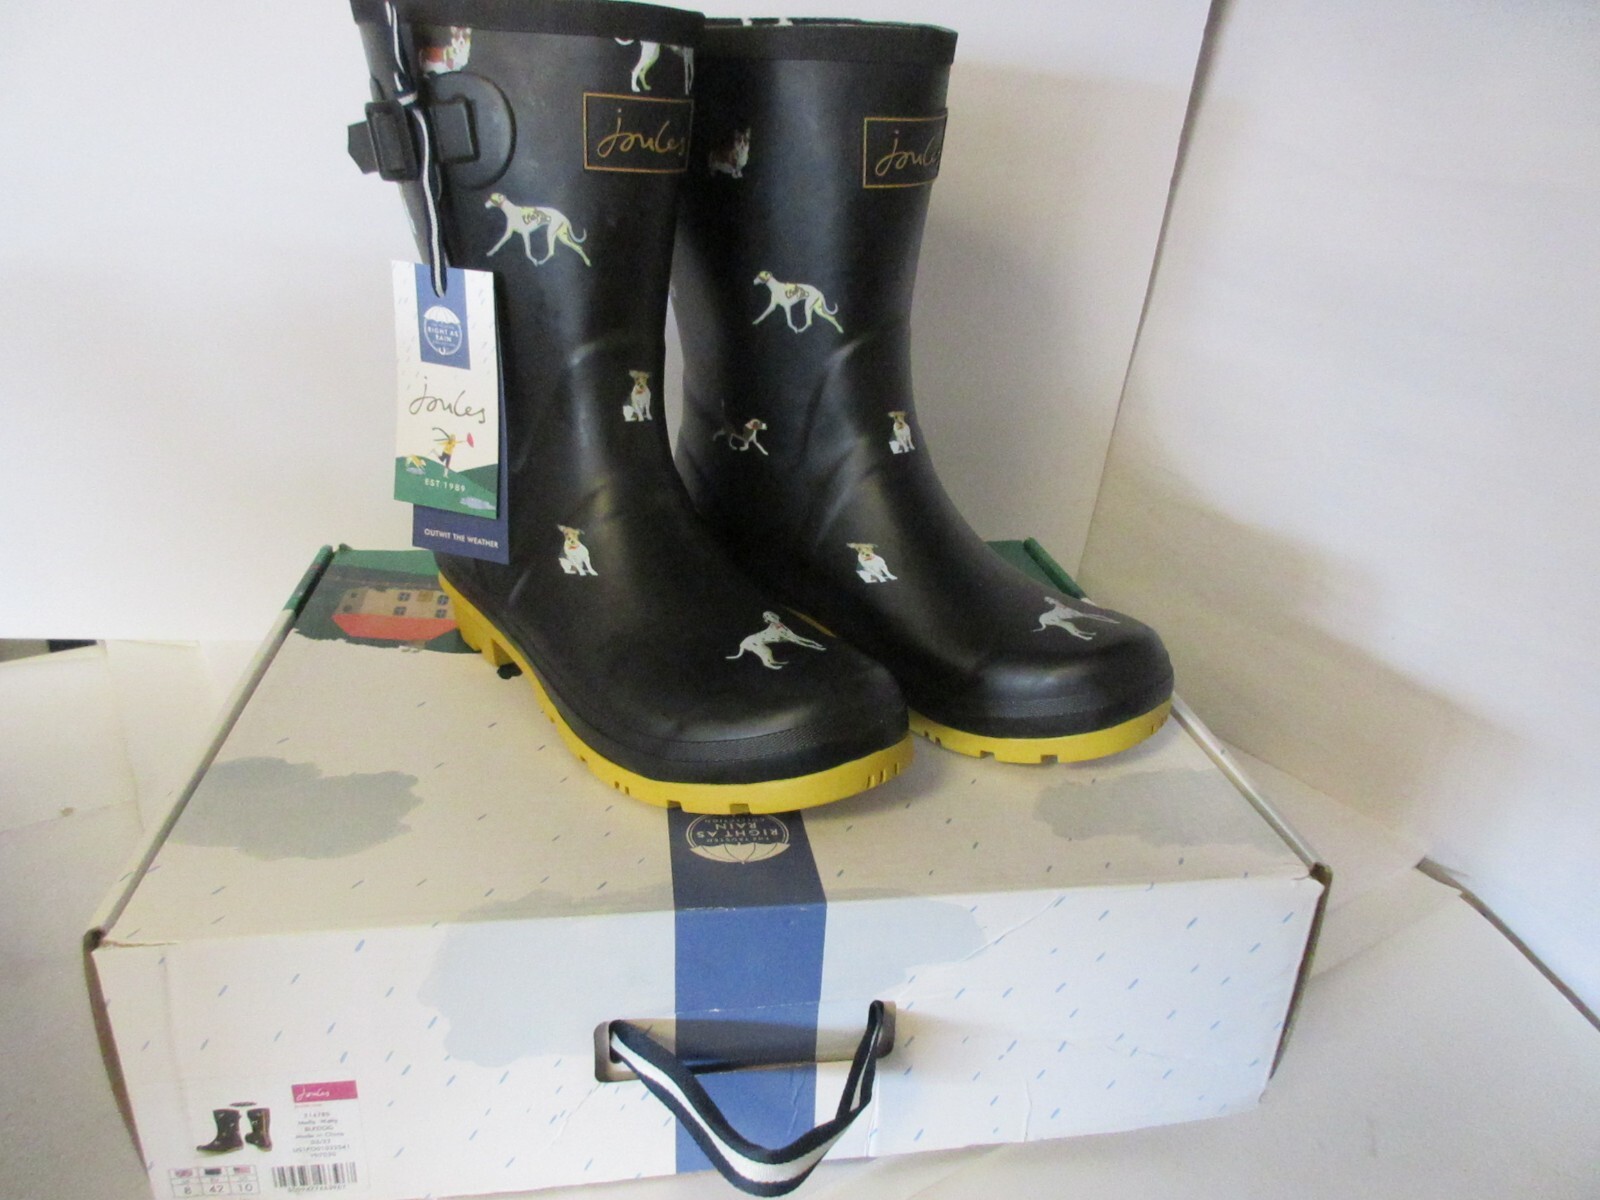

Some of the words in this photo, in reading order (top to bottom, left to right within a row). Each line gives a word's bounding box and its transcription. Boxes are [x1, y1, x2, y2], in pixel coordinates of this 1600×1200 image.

[424, 478, 440, 487] EST
[444, 481, 466, 492] 1989
[424, 528, 451, 539] OUTWIT
[453, 533, 465, 542] THE
[467, 535, 499, 548] WEATHER
[715, 822, 757, 830] RAIN
[696, 830, 718, 838] AS
[725, 828, 779, 837] RIGHT
[184, 1185, 192, 1194] 8
[209, 1184, 224, 1193] 42
[238, 1183, 253, 1192] 10
